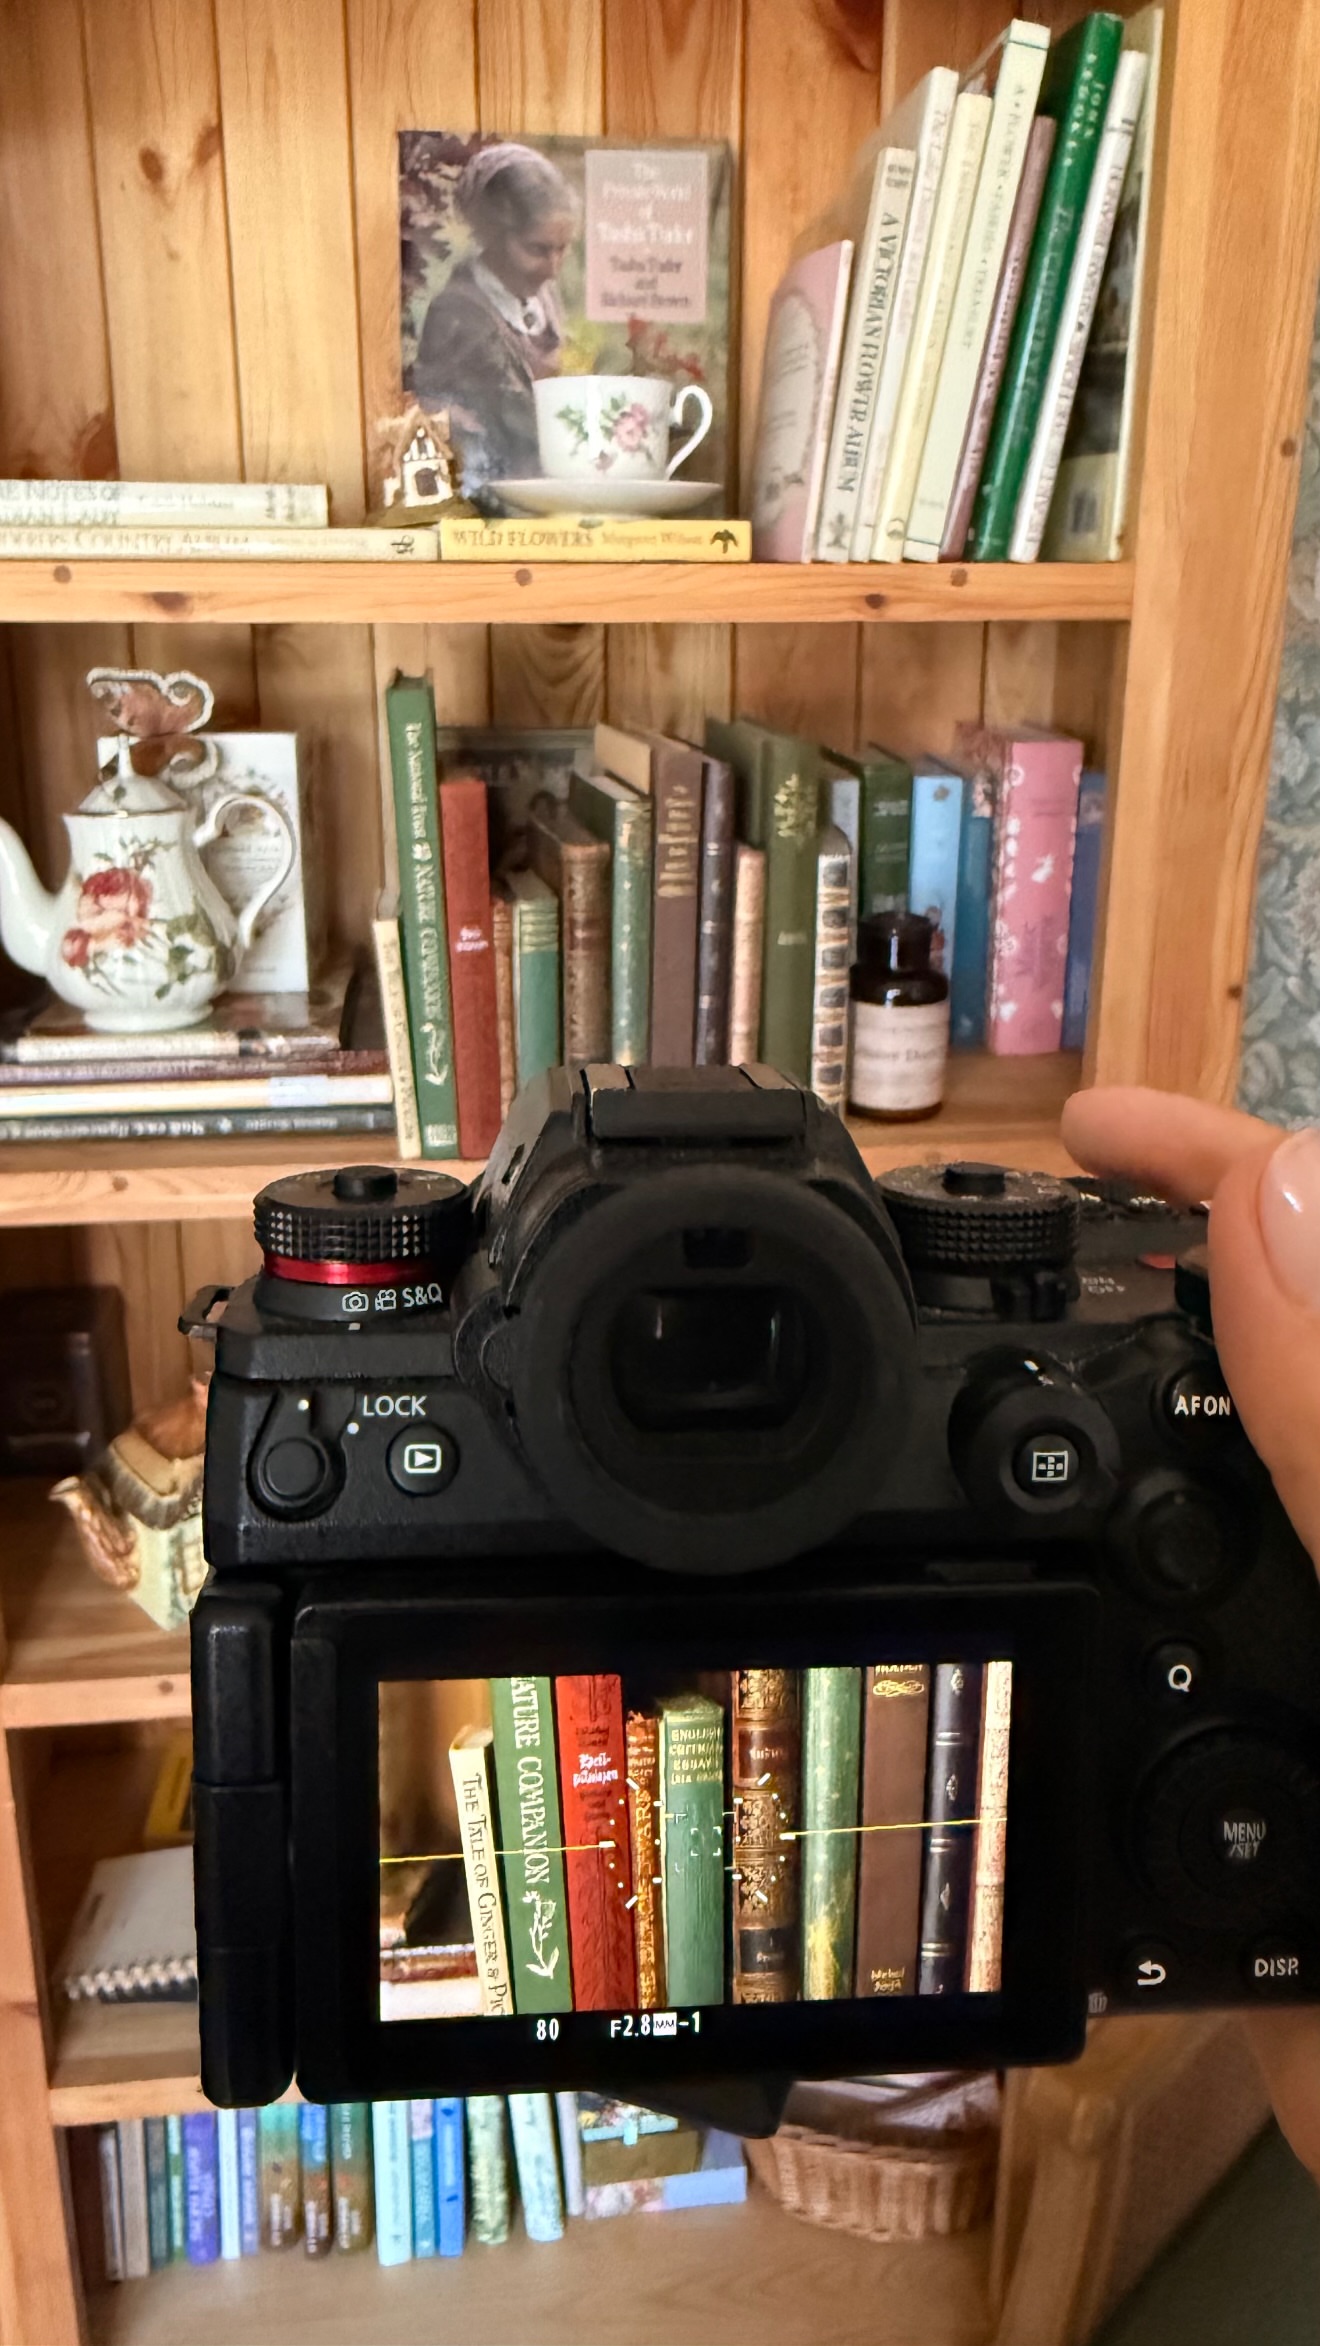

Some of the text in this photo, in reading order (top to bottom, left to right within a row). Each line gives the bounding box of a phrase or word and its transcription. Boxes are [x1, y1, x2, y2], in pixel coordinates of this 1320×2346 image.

[452, 529, 593, 547] WILD FLOWERS
[401, 1283, 443, 1307] S&Q
[362, 1395, 427, 1416] LOCK
[1168, 1664, 1192, 1692] Q
[462, 1772, 482, 1806] THE
[516, 1757, 551, 1884] COMPANION
[1223, 1821, 1267, 1842] MENU
[464, 1813, 490, 1860] TALE
[473, 1861, 490, 1889] OF
[476, 1890, 500, 1964] GINGER
[536, 2018, 560, 2041] 80
[610, 2014, 651, 2039] F2.8
